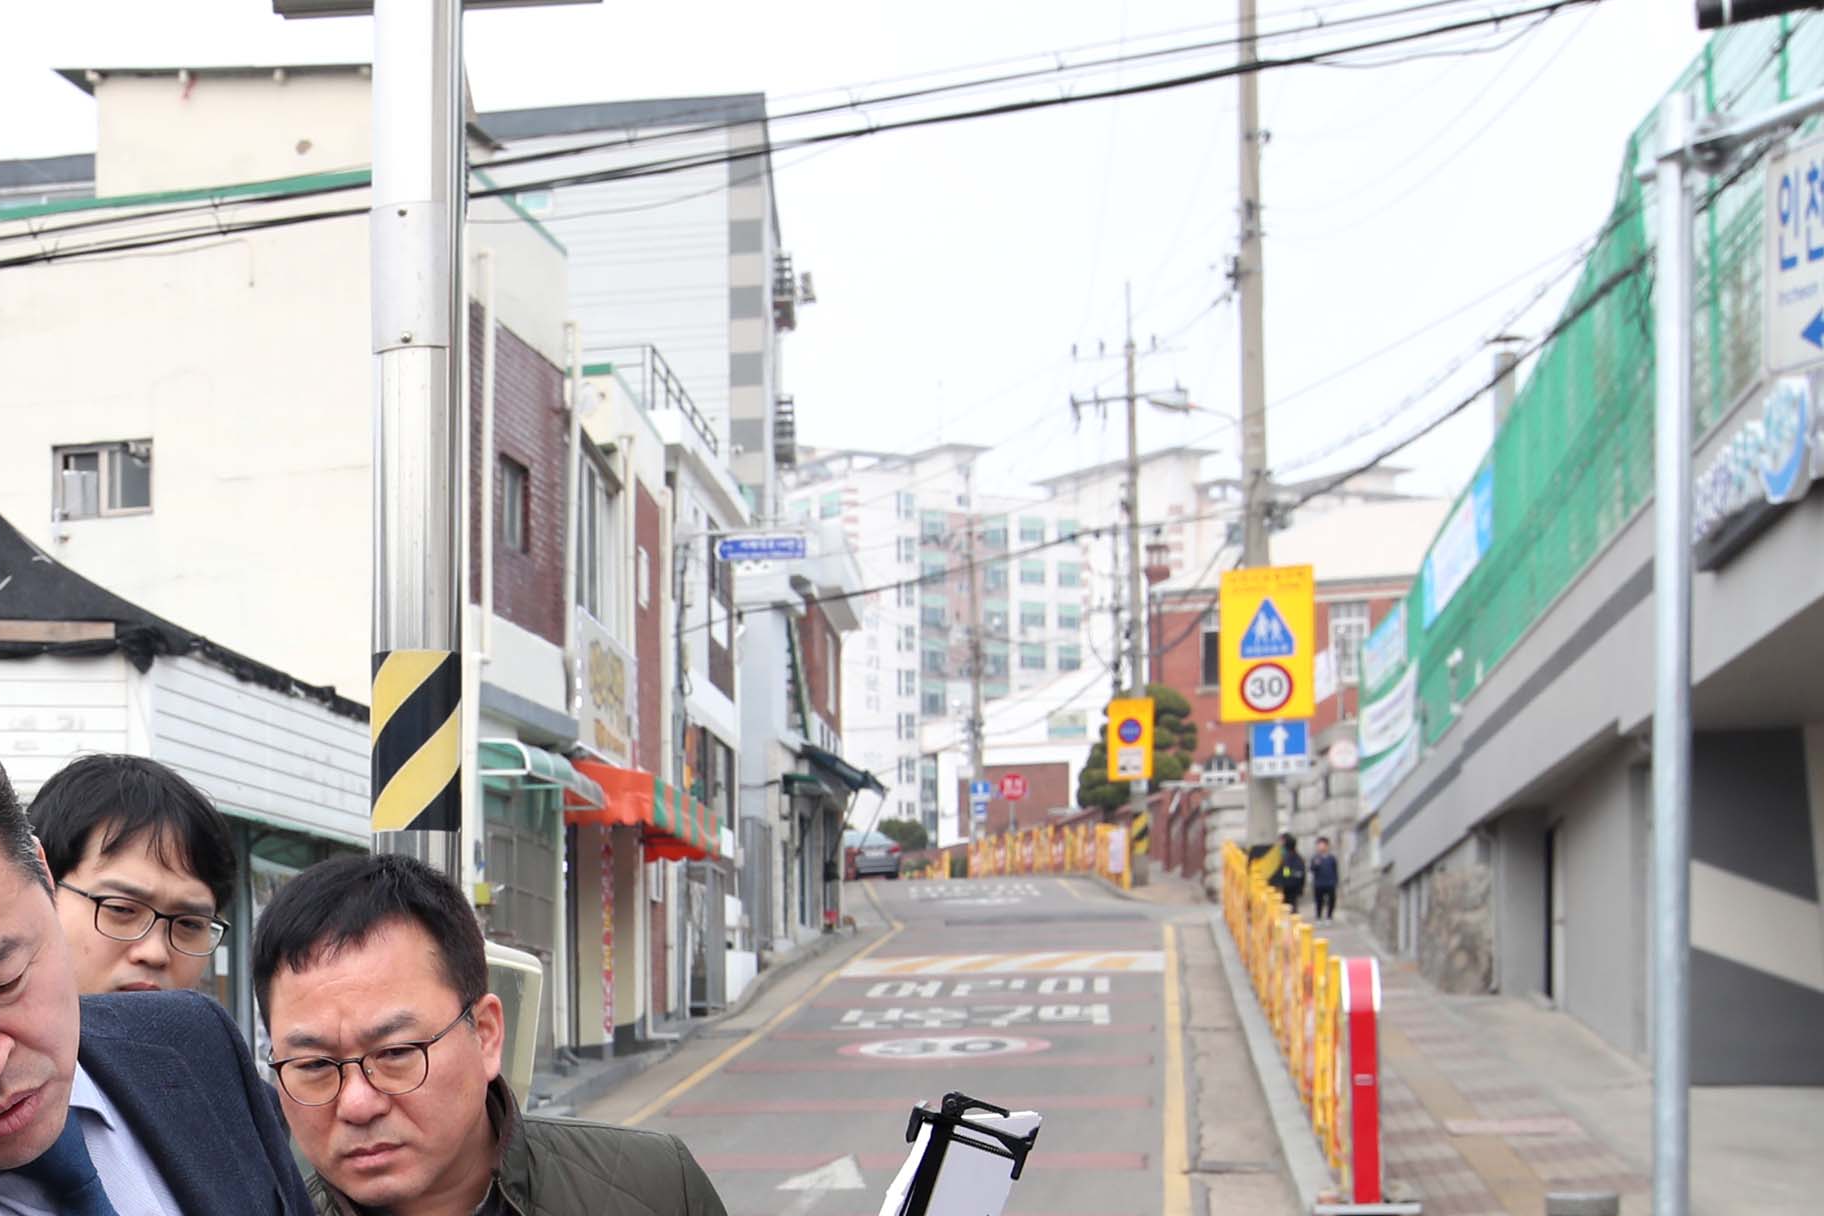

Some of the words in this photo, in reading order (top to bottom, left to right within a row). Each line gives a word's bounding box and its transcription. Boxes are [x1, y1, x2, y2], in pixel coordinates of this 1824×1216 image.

[1250, 675, 1285, 699] 30
[830, 1002, 1112, 1030] 보호구역
[875, 1036, 1010, 1057] 30
